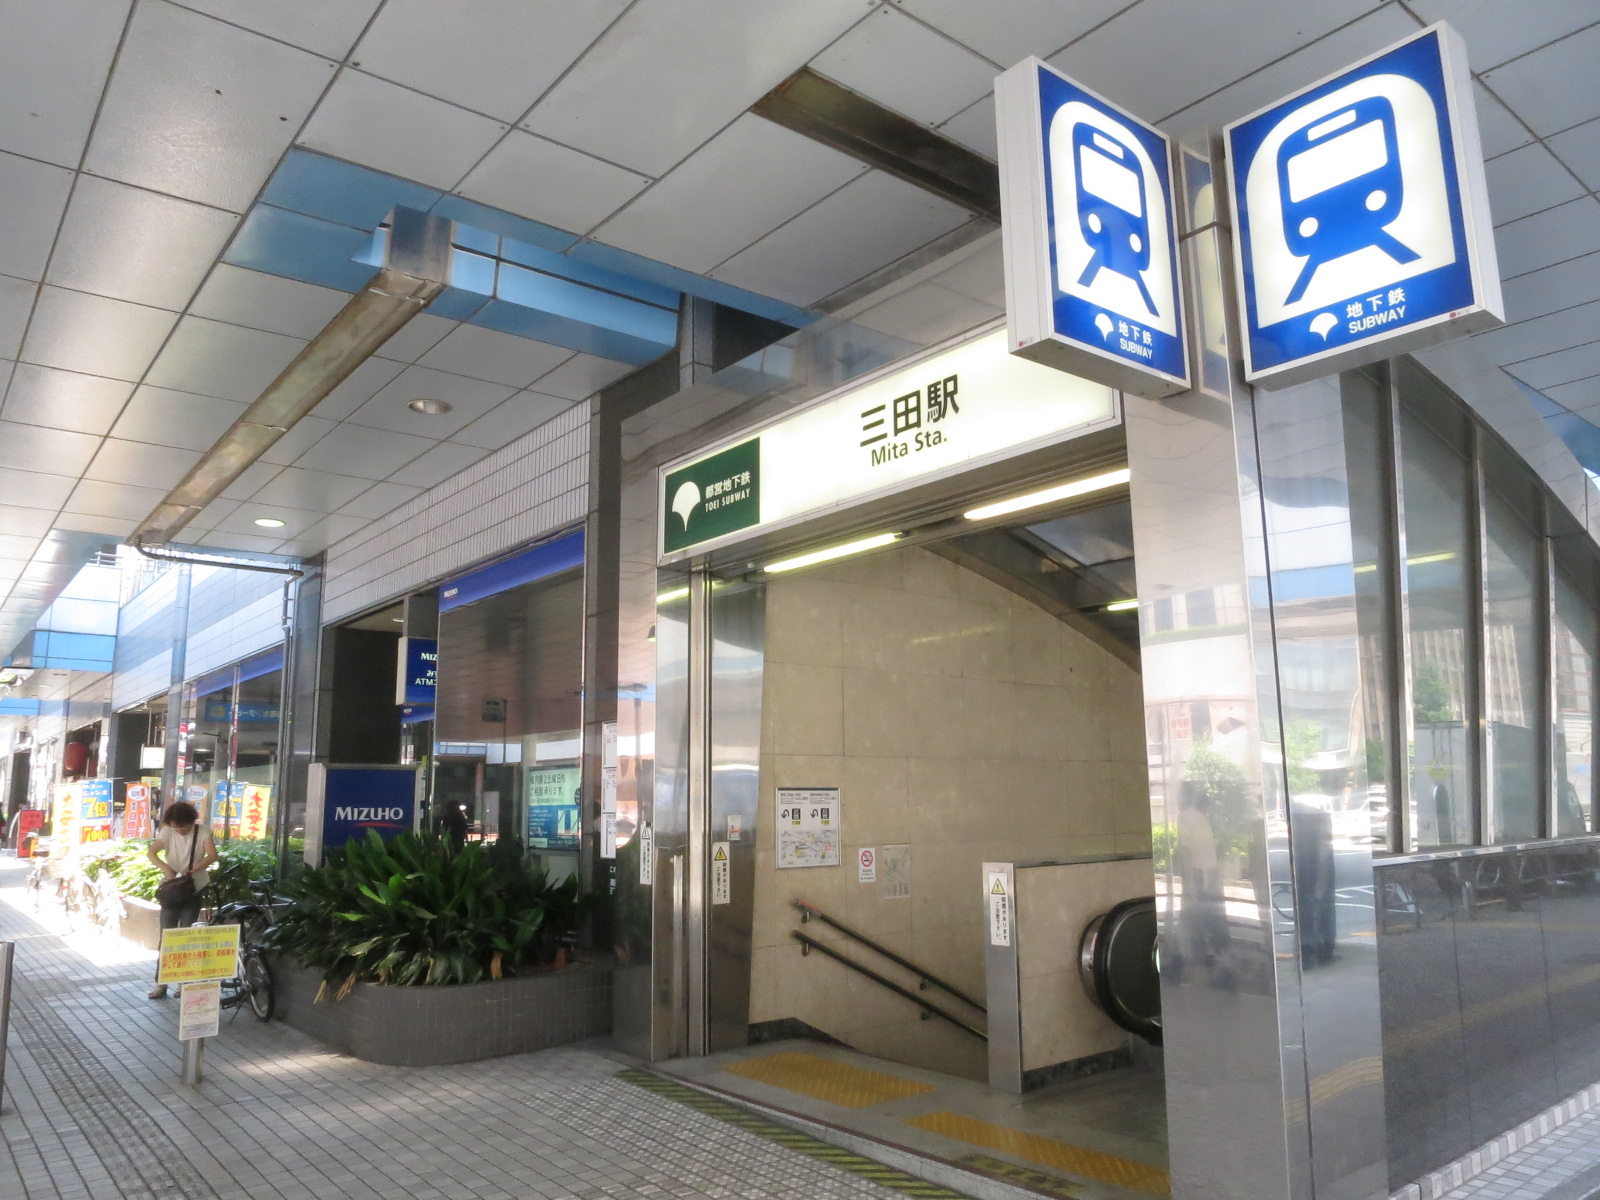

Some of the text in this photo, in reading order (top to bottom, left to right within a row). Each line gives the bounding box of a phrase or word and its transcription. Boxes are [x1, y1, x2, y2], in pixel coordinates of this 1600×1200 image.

[1346, 286, 1407, 318] 地下鉄
[1118, 320, 1153, 346] 地下鉄
[1348, 305, 1407, 334] SUBWAY
[1120, 338, 1153, 359] SUBWAY
[860, 374, 960, 447] 三田駅
[871, 426, 948, 467] Mita Sta.
[705, 471, 751, 499] 都営地下鉄
[705, 487, 751, 512] TOEI SUBWAY
[420, 652, 438, 662] MIZ
[334, 806, 404, 821] MIZUHO
